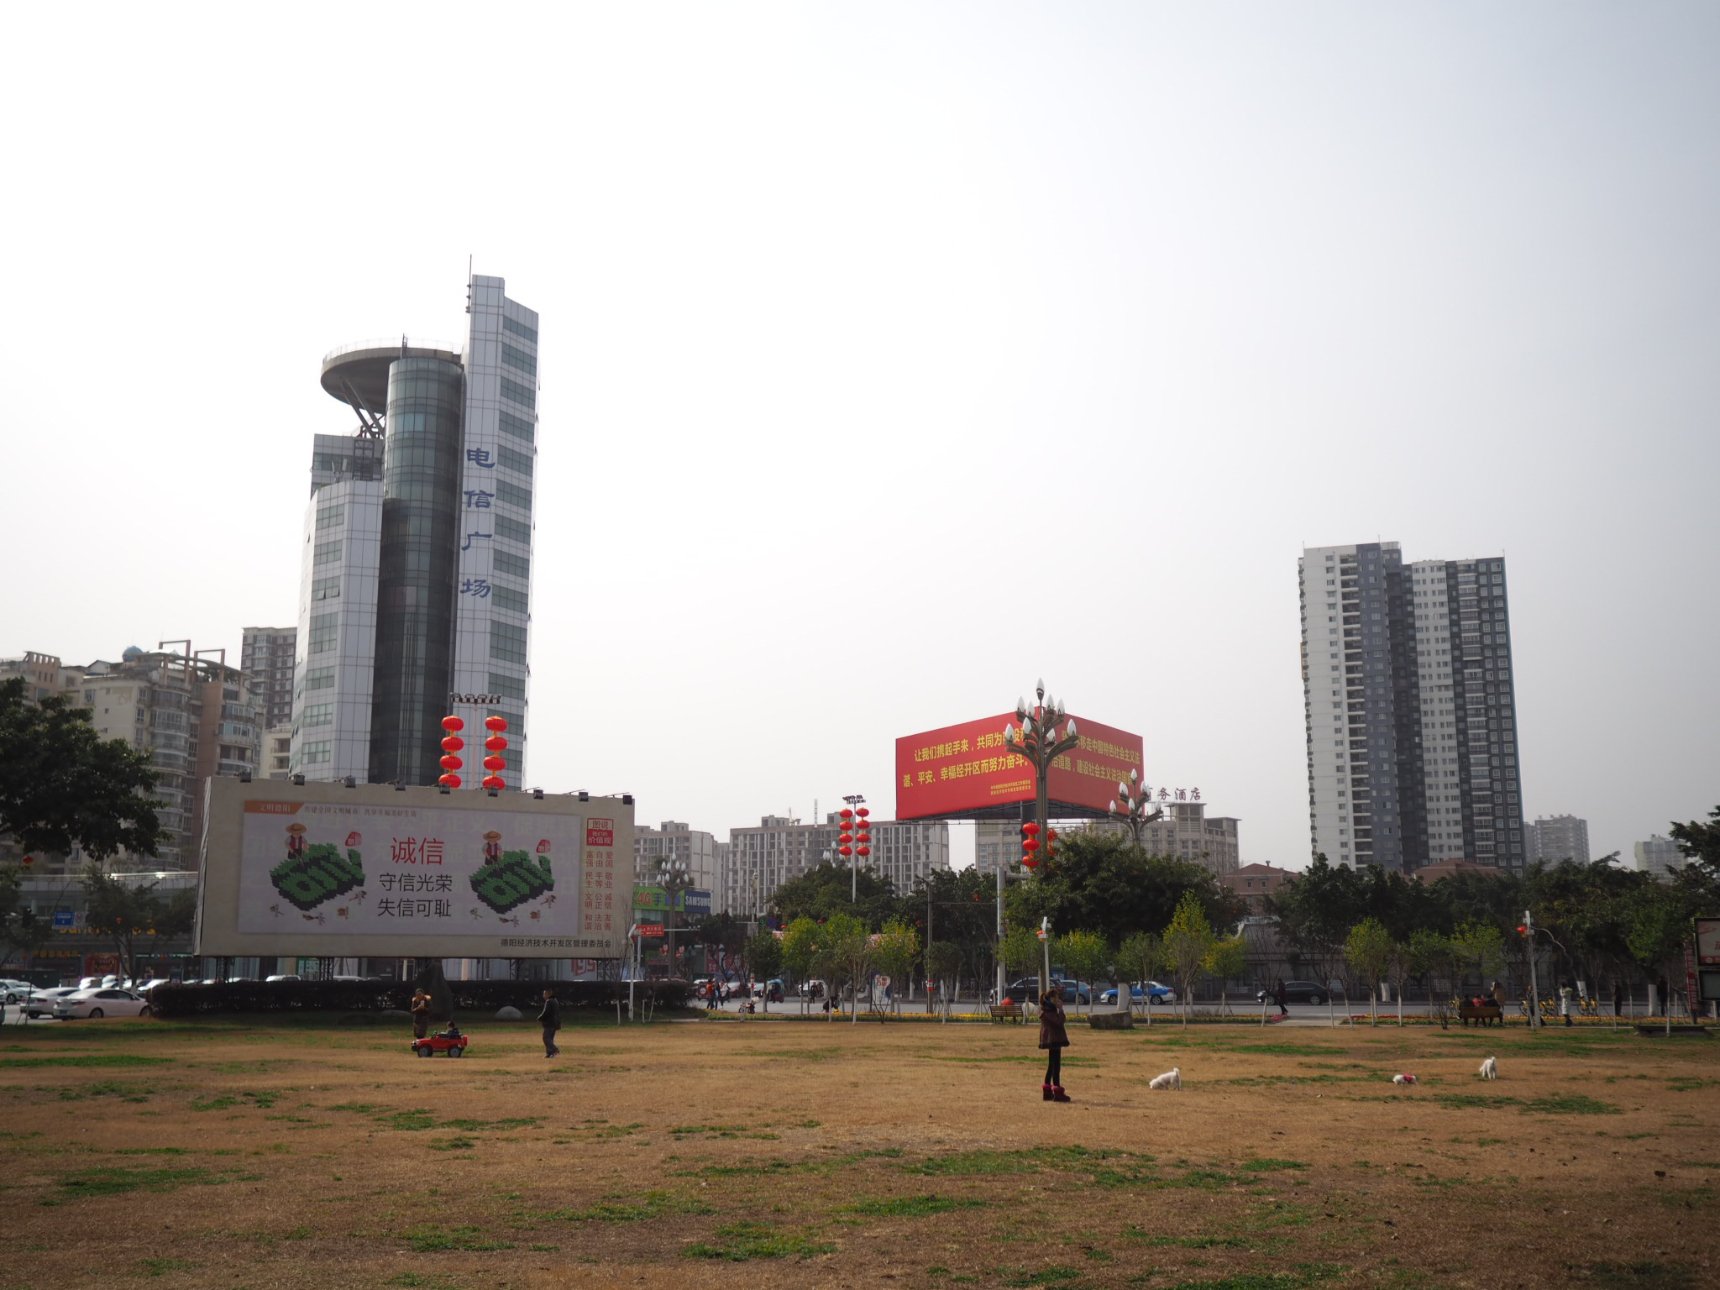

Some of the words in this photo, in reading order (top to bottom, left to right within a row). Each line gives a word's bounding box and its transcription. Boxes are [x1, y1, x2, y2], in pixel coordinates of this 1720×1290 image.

[460, 448, 496, 598] 电信广场
[914, 727, 1025, 762] 让我们携起手来，共同为设
[390, 837, 445, 865] 诚信
[379, 872, 453, 893] 守信光荣
[377, 897, 452, 918] 失信可耻
[685, 896, 711, 907] SAMSUNG
